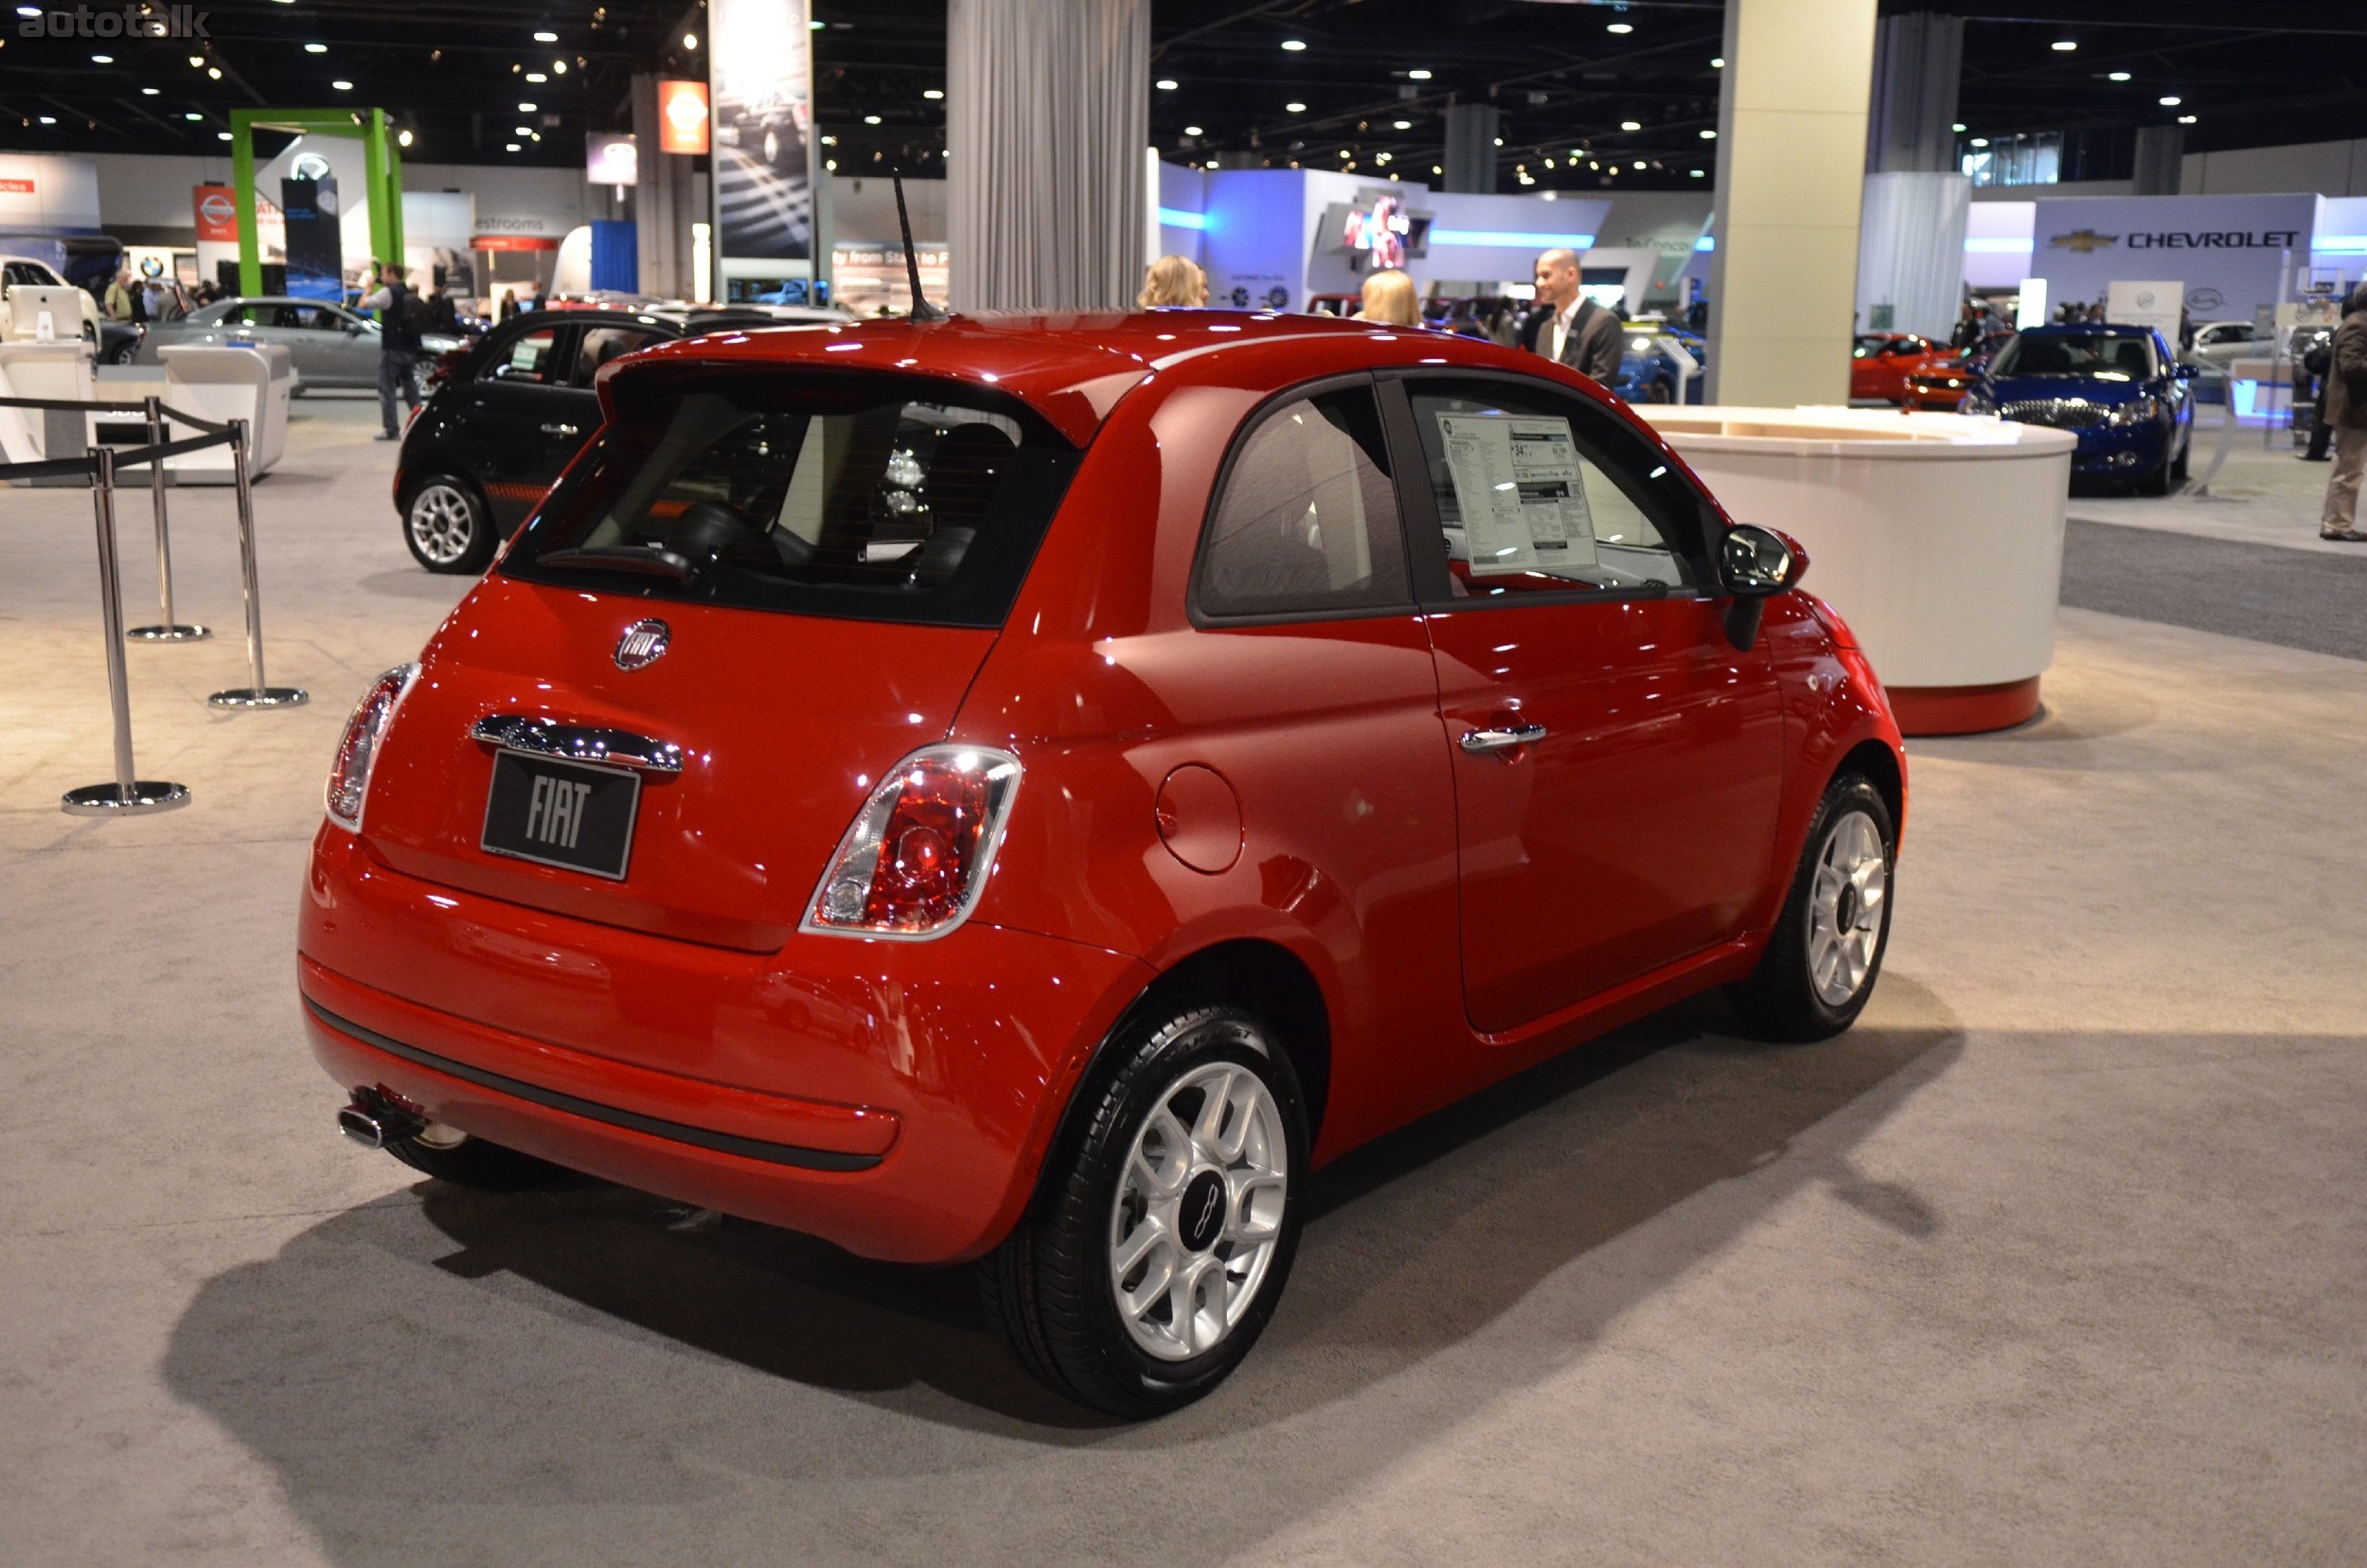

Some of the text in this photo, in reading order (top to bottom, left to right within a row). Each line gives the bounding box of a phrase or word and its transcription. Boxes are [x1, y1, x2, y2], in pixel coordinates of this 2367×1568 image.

[475, 216, 544, 231] estrooms
[2127, 231, 2301, 248] CHEVROLET
[623, 631, 661, 656] FIAT
[525, 775, 592, 849] FIAT
